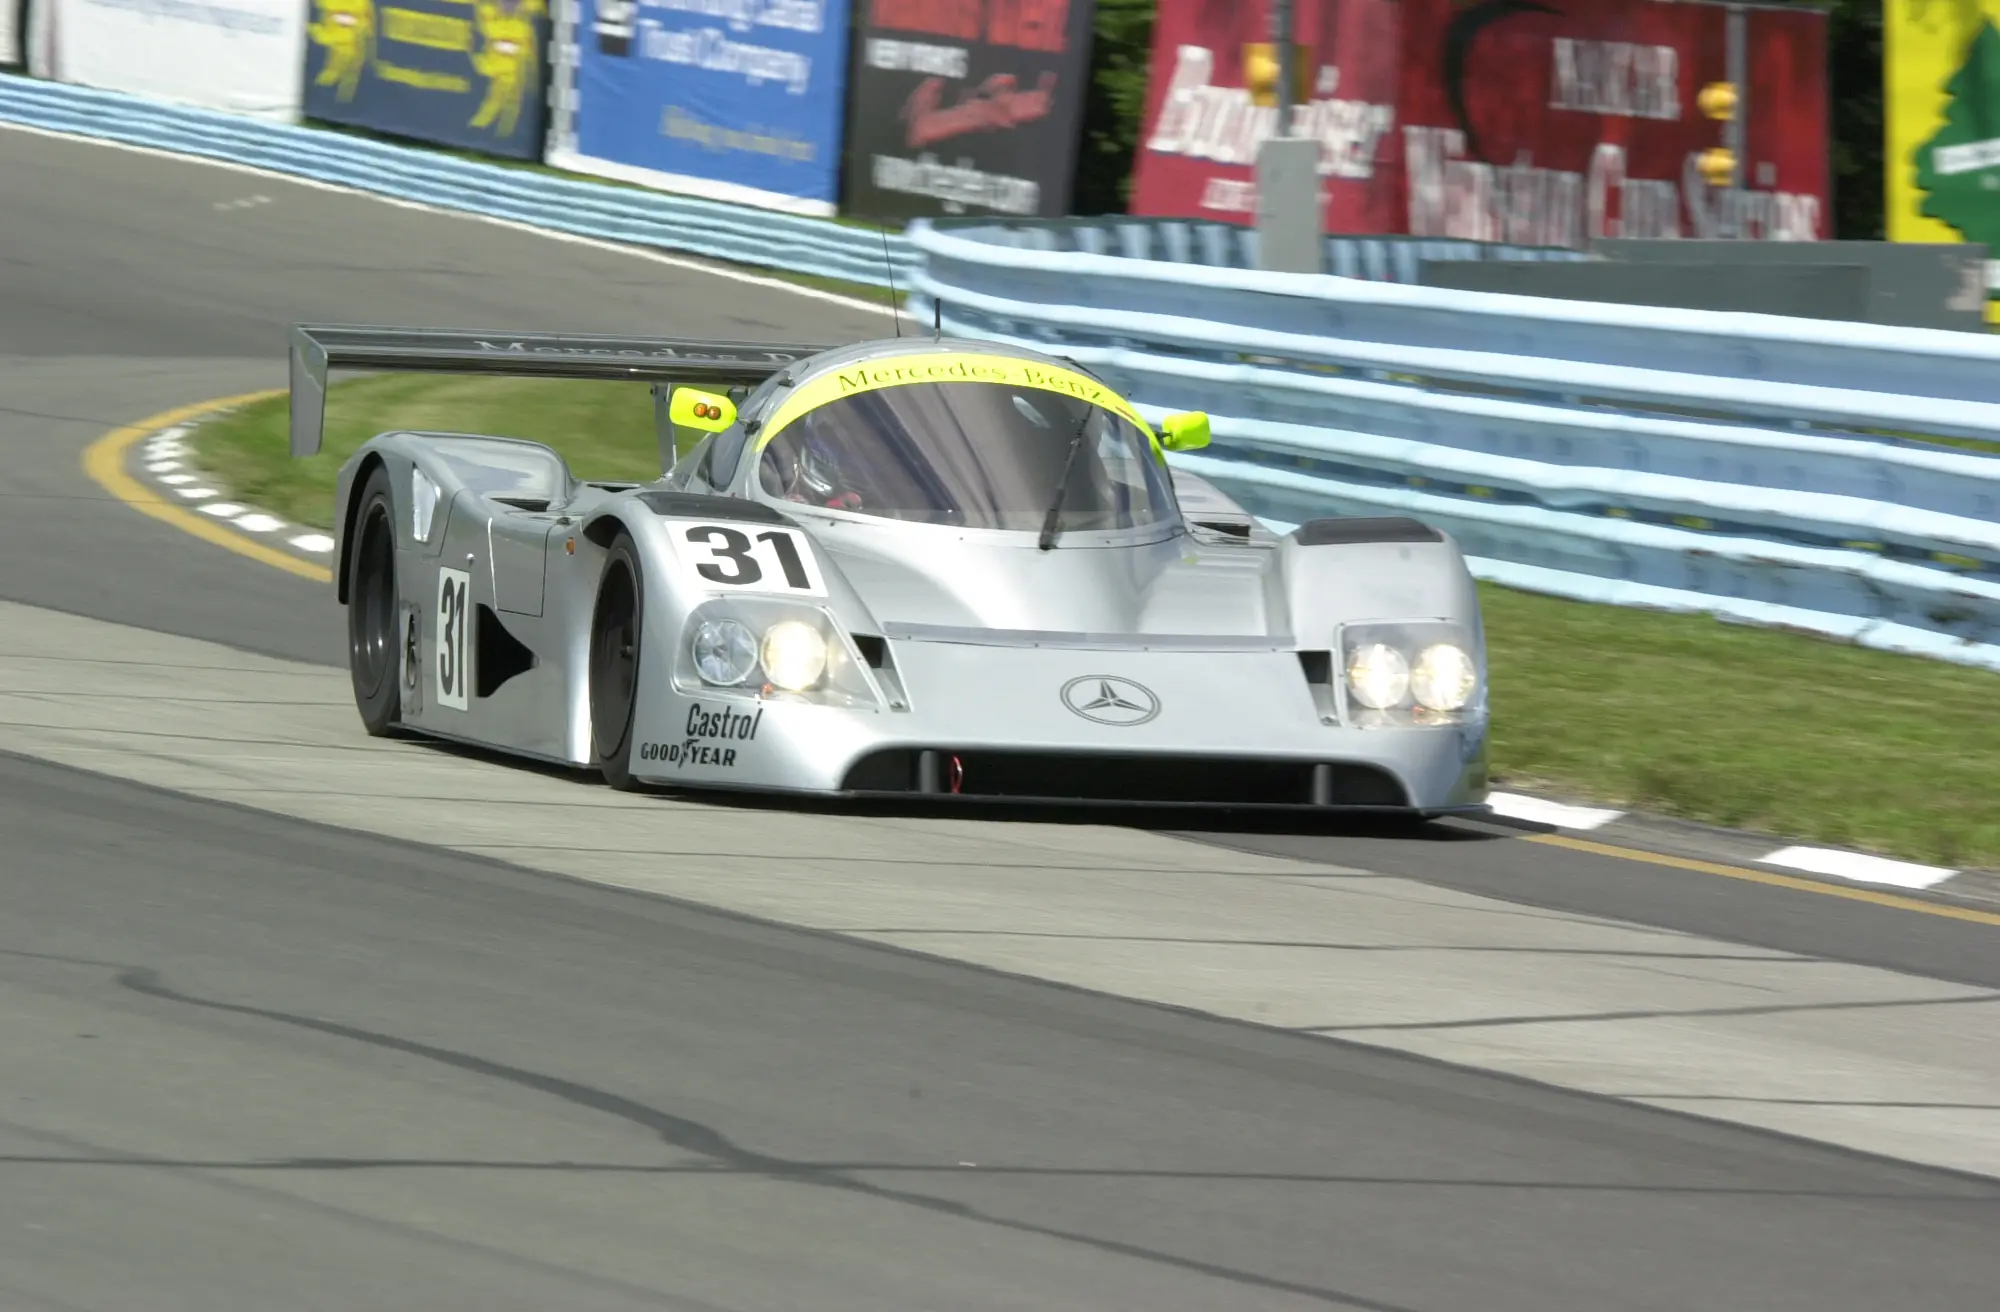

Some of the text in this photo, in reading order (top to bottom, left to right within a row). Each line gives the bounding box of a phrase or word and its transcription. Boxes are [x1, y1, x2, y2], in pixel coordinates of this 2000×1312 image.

[685, 525, 812, 590] 31
[440, 576, 466, 697] 31
[686, 702, 763, 740] Castrol
